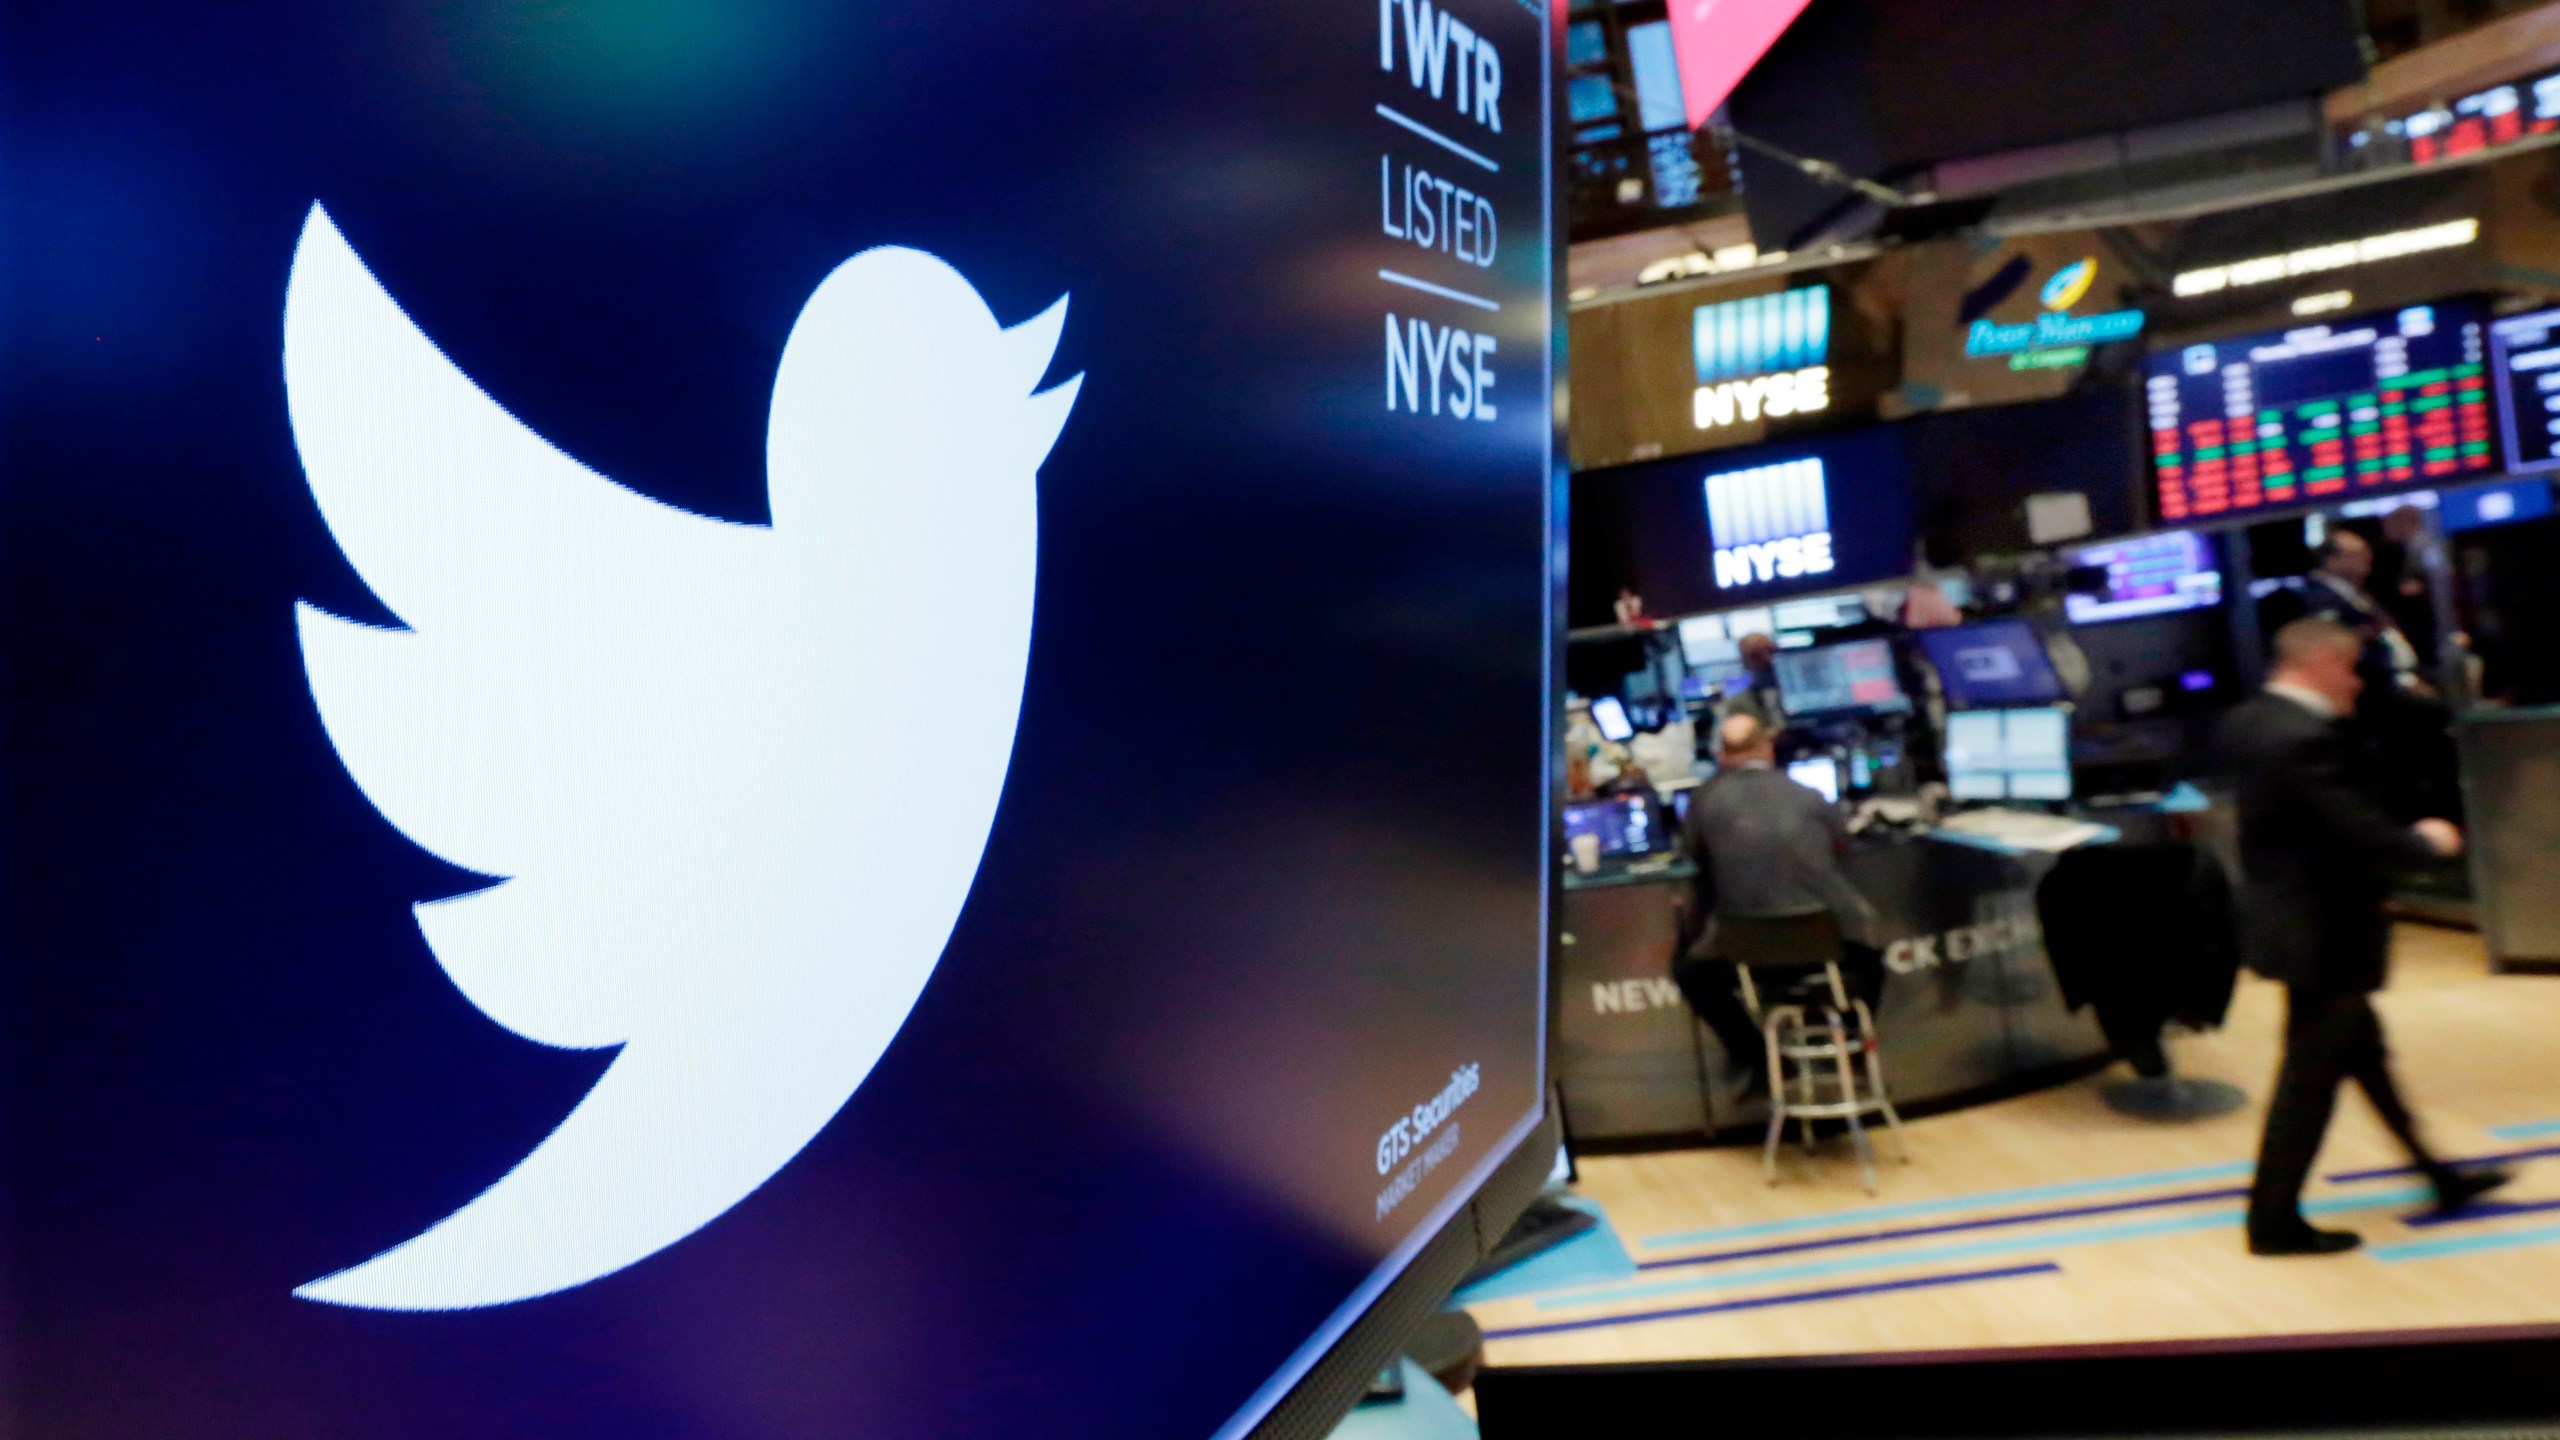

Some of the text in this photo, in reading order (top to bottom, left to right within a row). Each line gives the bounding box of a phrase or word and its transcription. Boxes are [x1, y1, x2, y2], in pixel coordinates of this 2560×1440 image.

[1380, 0, 1502, 133] TWTR
[1381, 154, 1497, 268] LISTED
[1385, 312, 1497, 421] NYSE
[1693, 364, 1830, 429] NYSE
[1713, 531, 1835, 589] NYSE
[1591, 976, 1682, 1014] NEW
[1377, 1116, 1411, 1175] GTS
